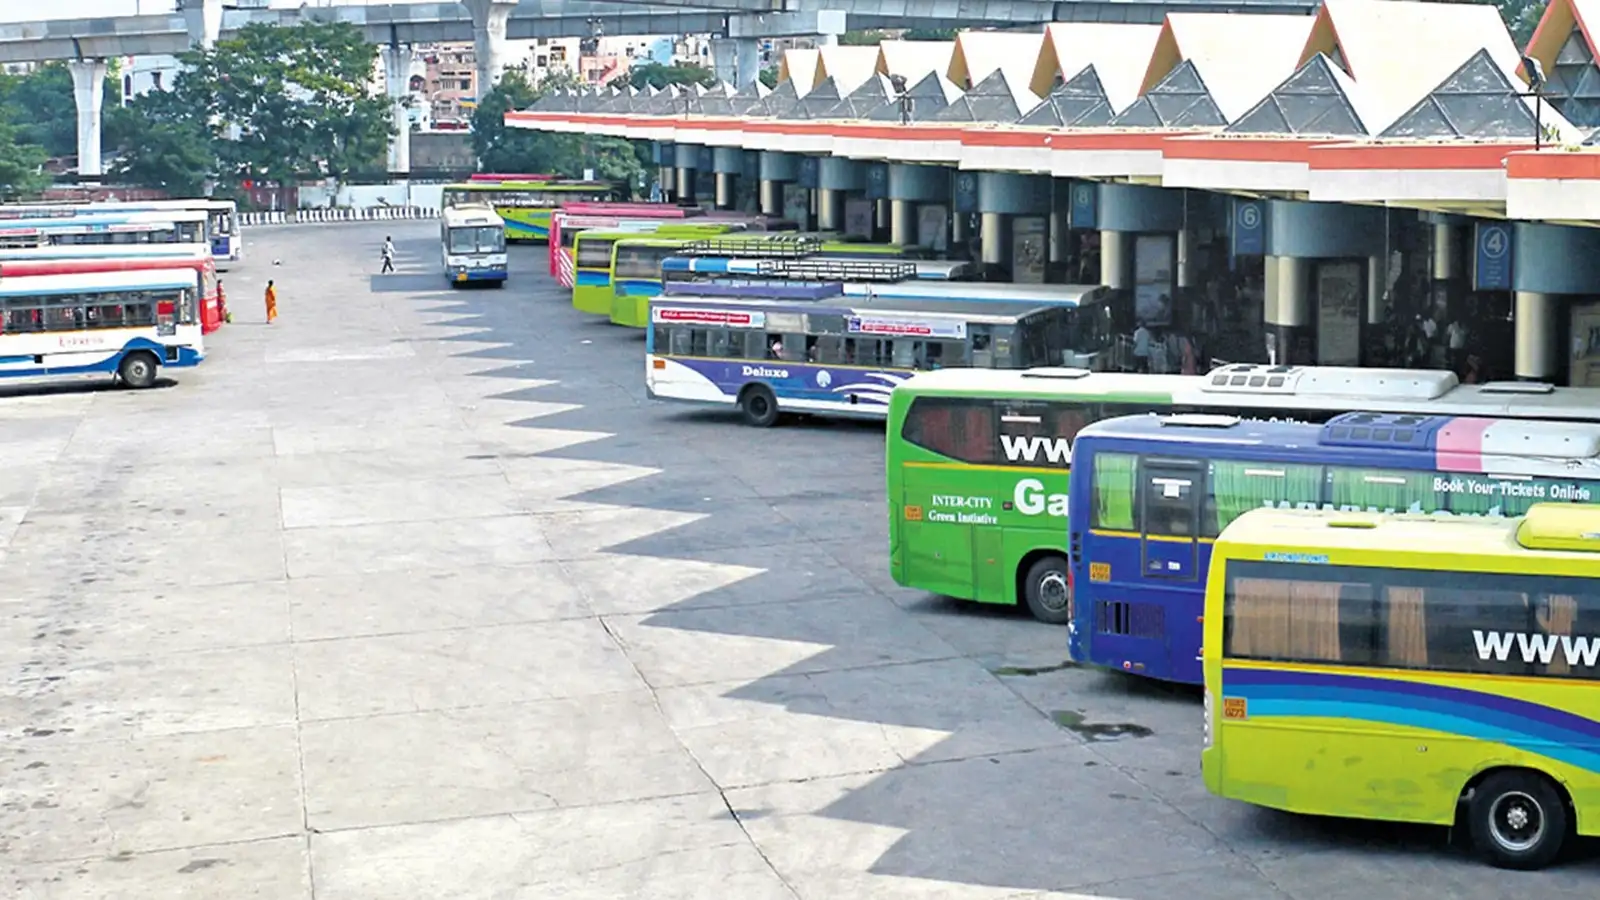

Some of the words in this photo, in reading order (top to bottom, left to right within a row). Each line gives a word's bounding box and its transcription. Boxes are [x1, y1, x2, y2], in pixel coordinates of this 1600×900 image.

[1078, 190, 1088, 204] 8
[1244, 208, 1256, 226] 6
[1487, 233, 1502, 253] 4
[742, 366, 789, 378] Deluxe
[1433, 477, 1464, 492] Book
[1467, 479, 1495, 495] Your
[1500, 482, 1545, 498] Tickets
[1550, 484, 1591, 500] Online
[931, 494, 994, 509] INTER-CITY
[928, 510, 956, 522] Green
[958, 511, 998, 525] Initiative
